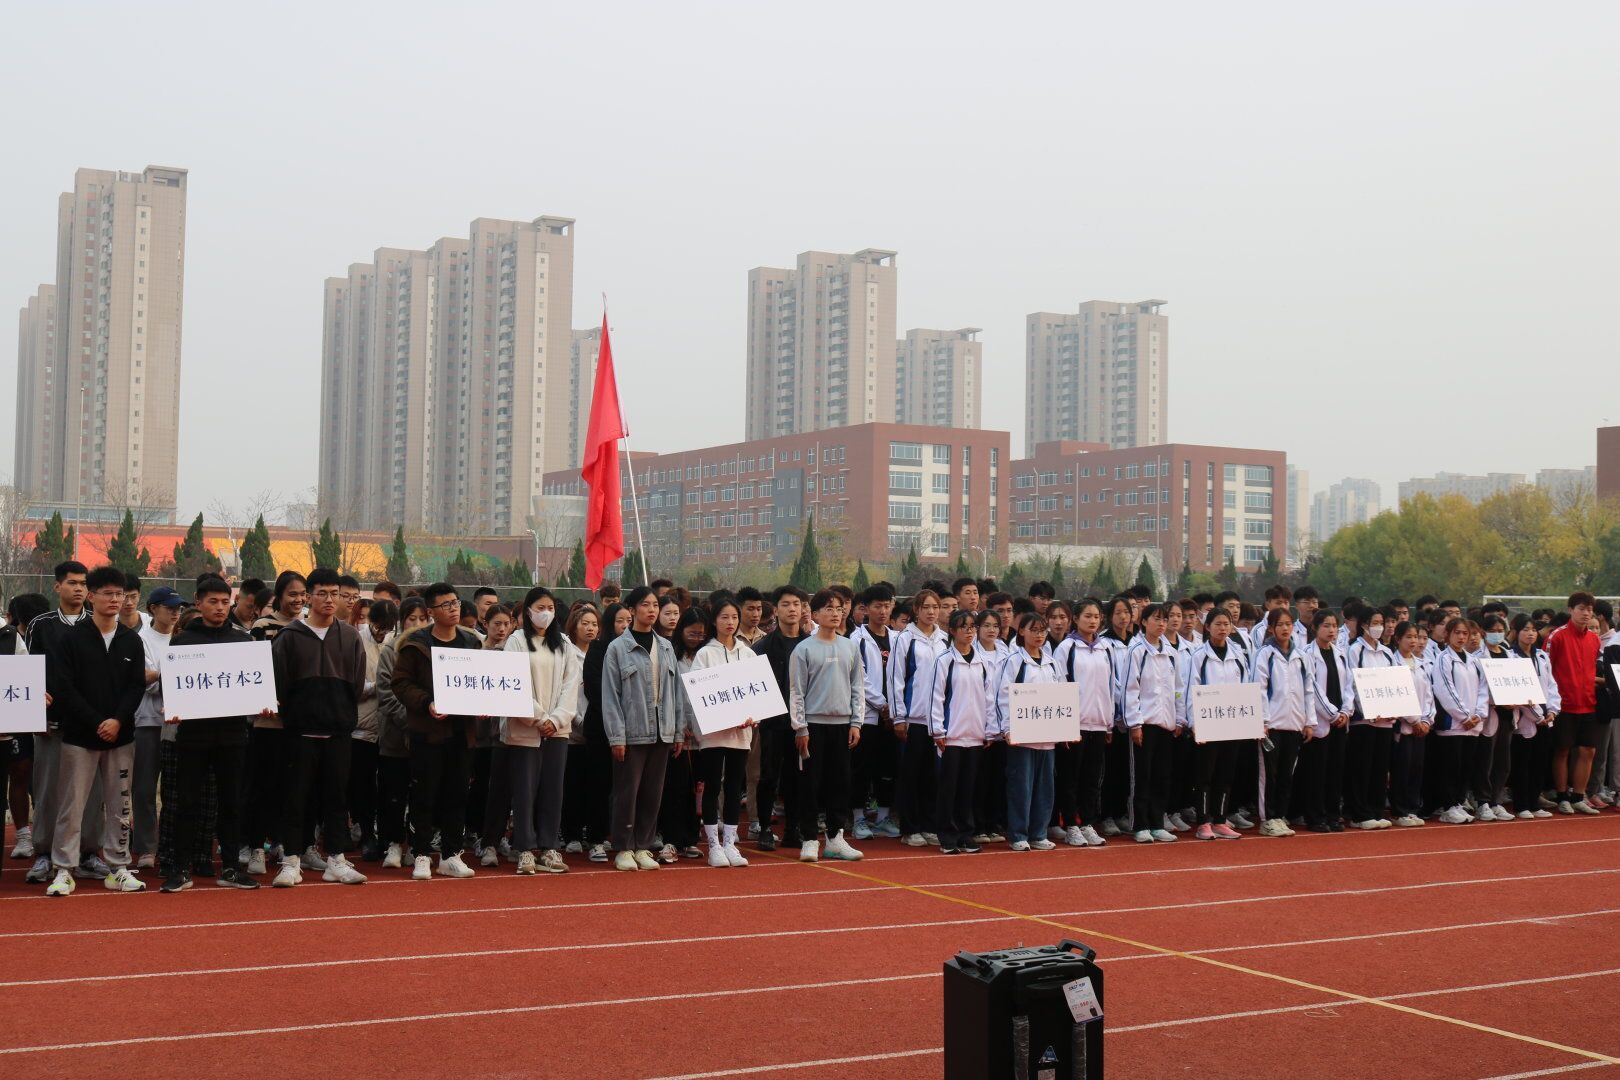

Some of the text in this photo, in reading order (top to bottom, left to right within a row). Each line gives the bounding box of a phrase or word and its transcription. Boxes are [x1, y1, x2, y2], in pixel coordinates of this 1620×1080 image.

[175, 670, 263, 690] 19体育本2
[445, 674, 521, 691] 19舞体本2
[3, 684, 31, 702] 本1
[701, 681, 769, 708] 19舞体本1
[1017, 705, 1073, 719] 21体育本2
[1201, 705, 1255, 719] 21体育本1
